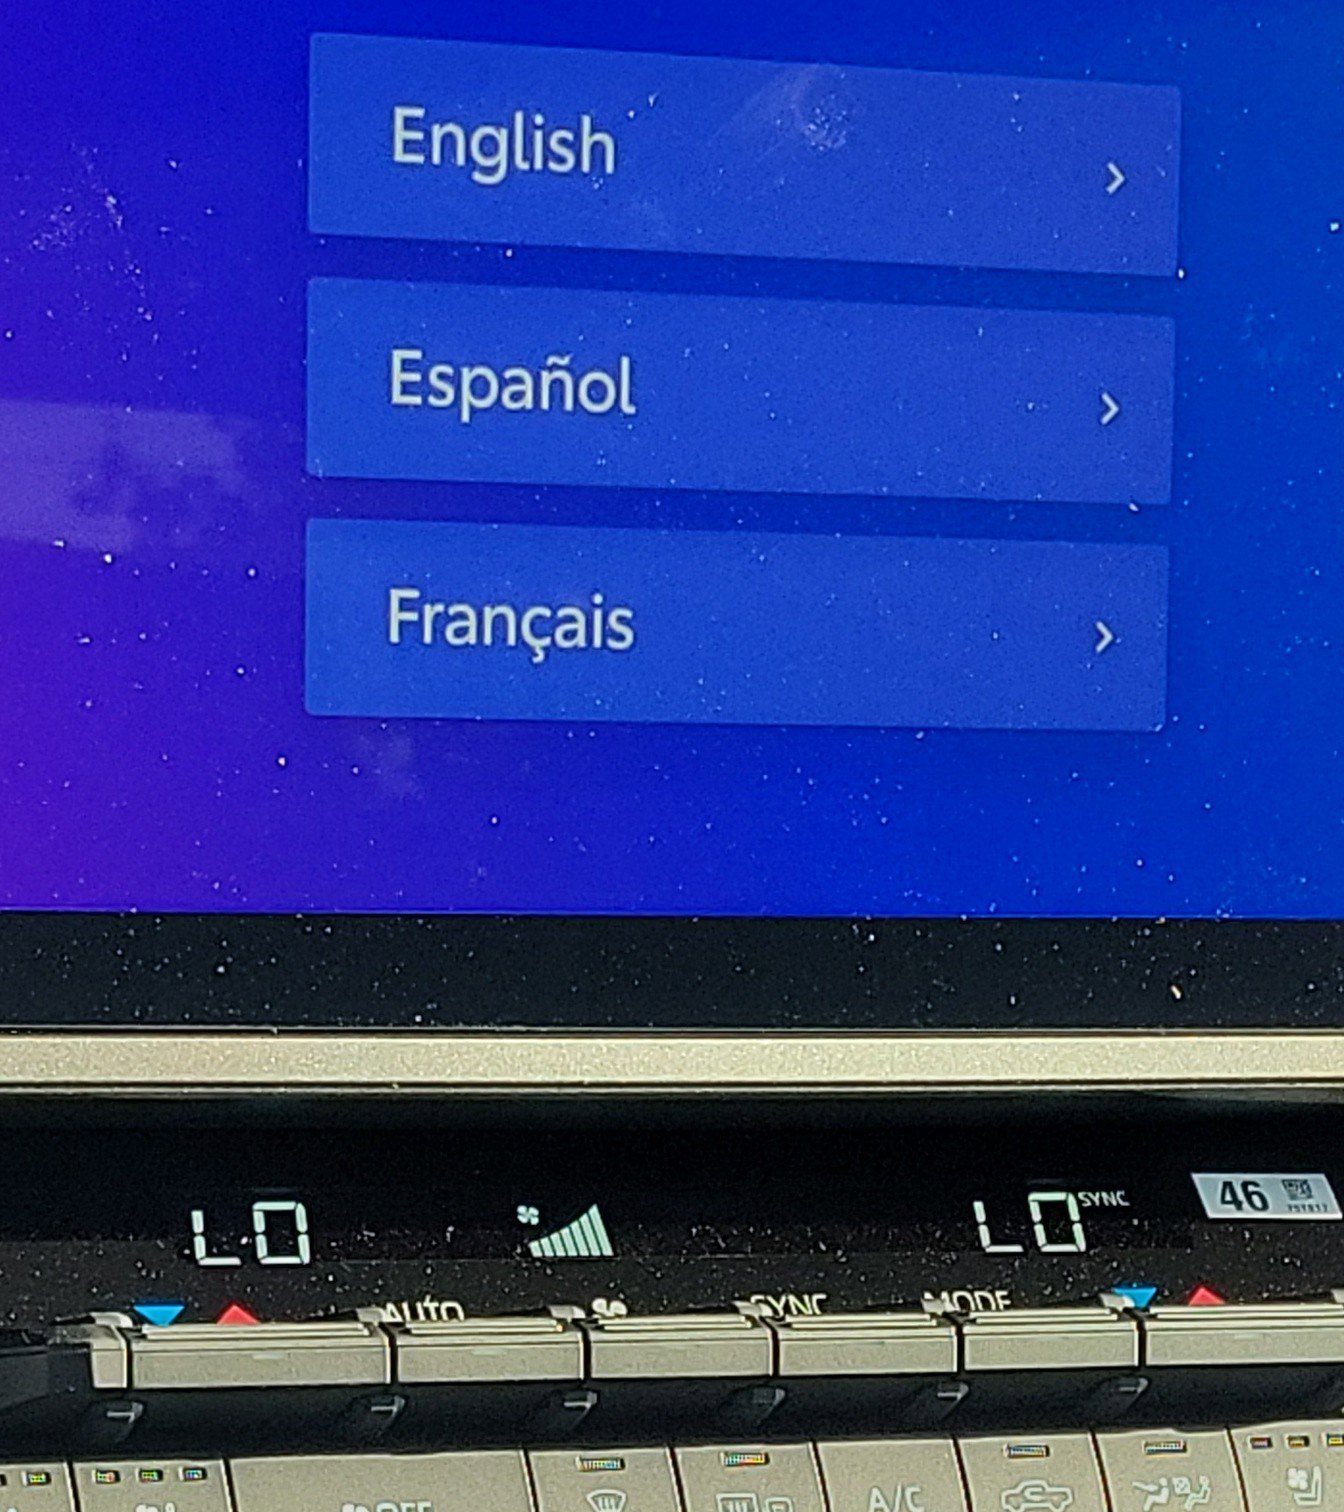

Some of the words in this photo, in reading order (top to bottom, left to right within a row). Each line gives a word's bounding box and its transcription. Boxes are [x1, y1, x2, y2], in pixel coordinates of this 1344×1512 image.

[392, 107, 618, 187] English
[389, 350, 638, 424] Español
[387, 588, 636, 663] Français
[1078, 1190, 1130, 1207] SYNC
[1220, 1180, 1269, 1211] 46
